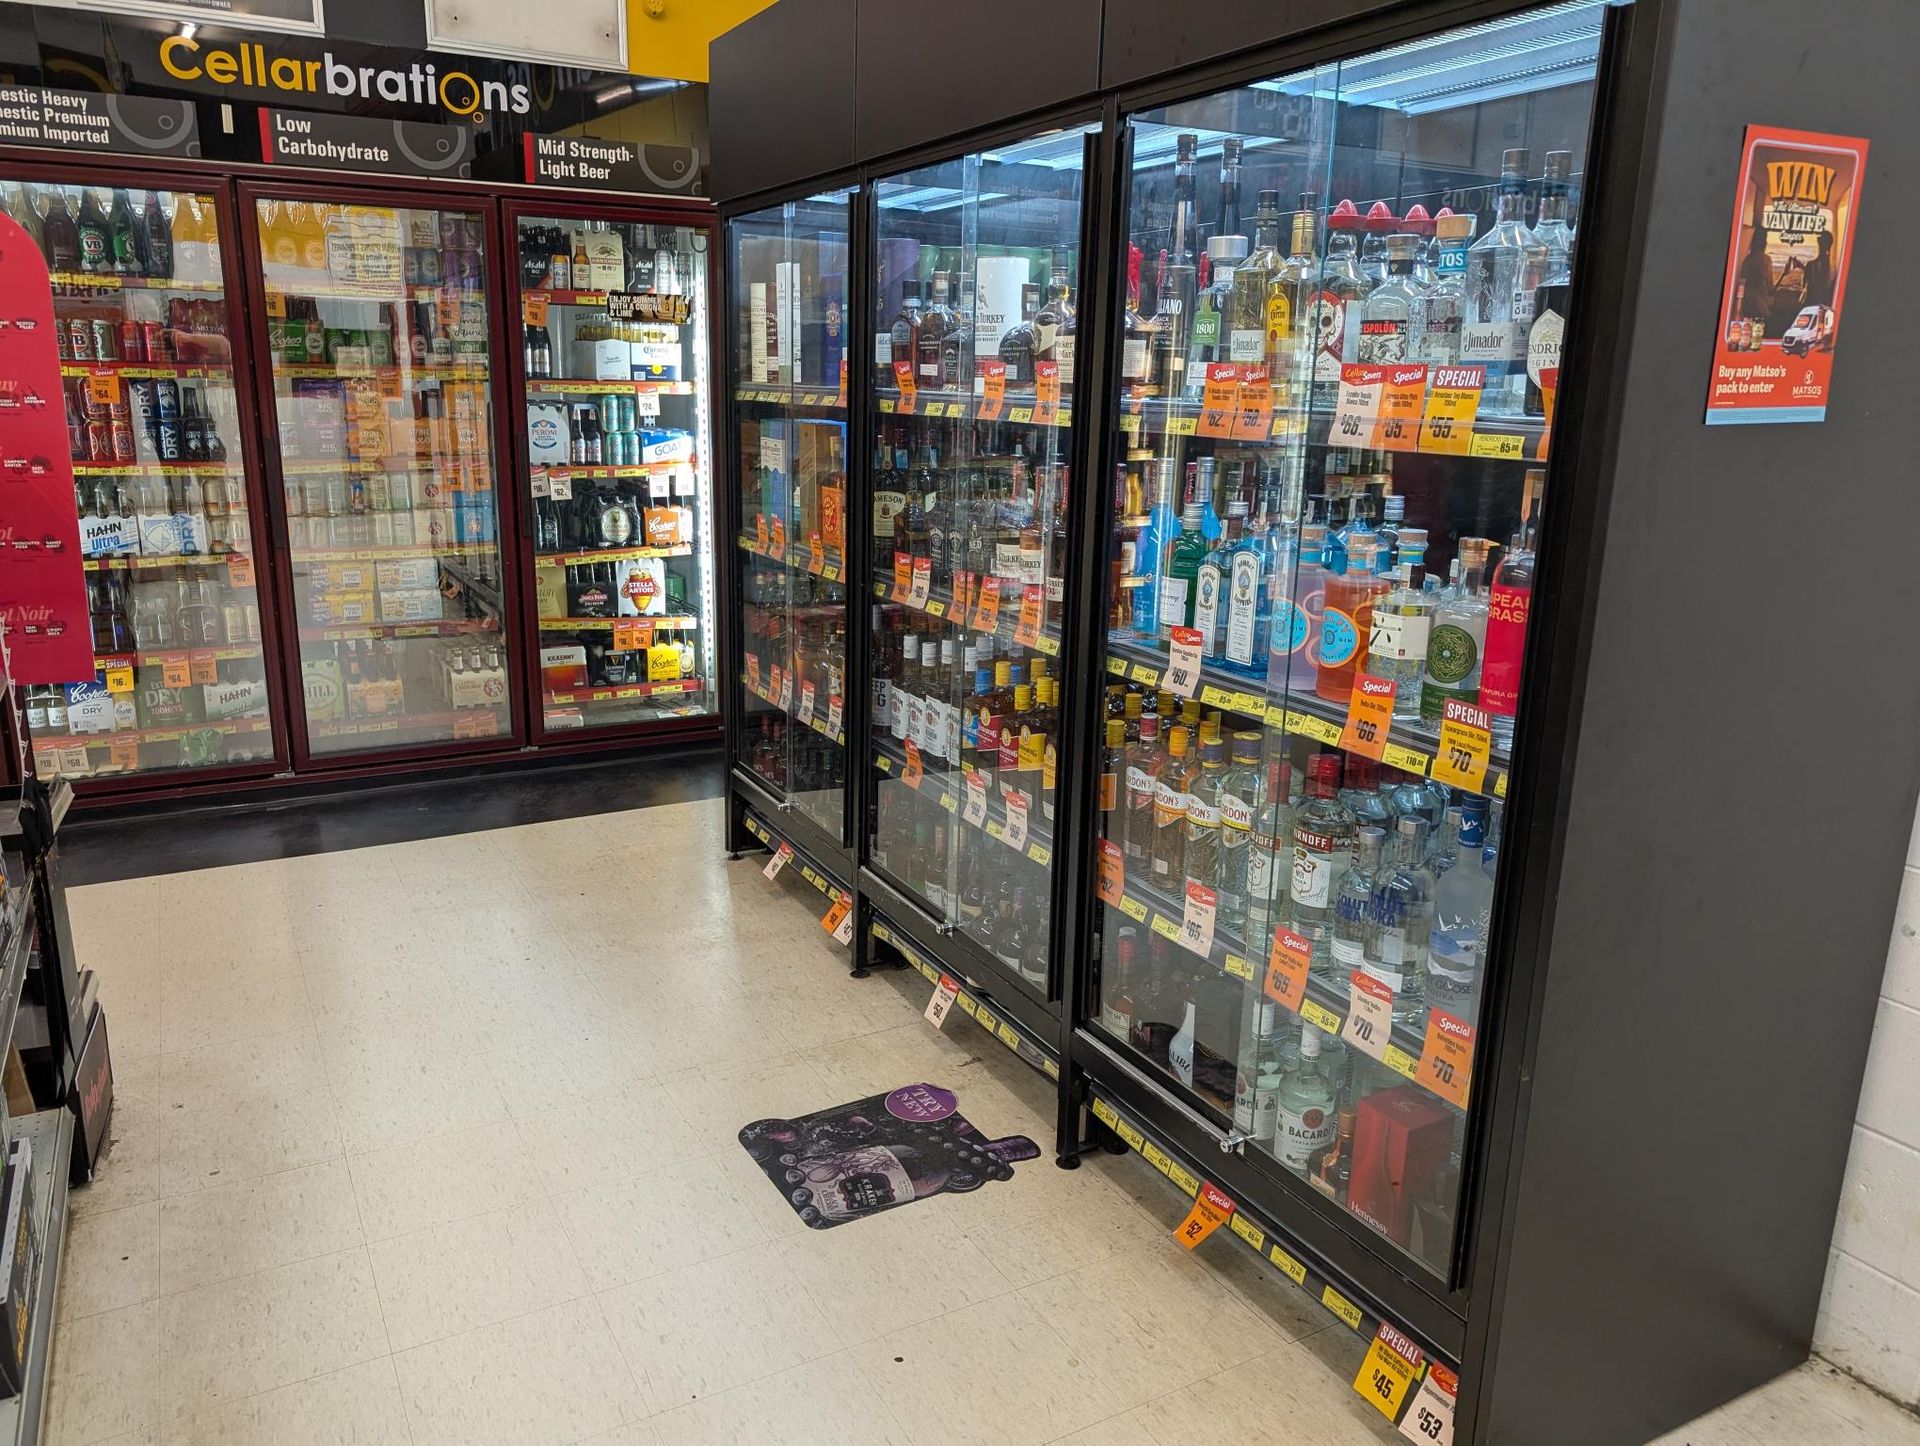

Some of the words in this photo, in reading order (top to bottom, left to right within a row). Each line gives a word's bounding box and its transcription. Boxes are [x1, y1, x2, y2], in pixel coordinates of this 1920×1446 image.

[160, 36, 529, 115] Cellarbrations
[42, 90, 88, 110] Heavy
[44, 109, 110, 127] Premium
[275, 115, 312, 134] Low
[43, 124, 110, 144] Imported
[278, 135, 390, 163] Carbohydrate
[537, 138, 568, 159] Mid
[538, 159, 576, 180] Light
[579, 162, 611, 180] Beer
[1766, 161, 1836, 204] WIN
[1763, 211, 1790, 230] VAN
[1792, 213, 1825, 231] LIFE
[86, 239, 102, 249] VB
[524, 259, 546, 270] Asahi
[635, 260, 653, 270] Asahi
[1440, 254, 1464, 267] TOS
[609, 295, 632, 304] ENJOY
[633, 296, 662, 304] SUMMER
[609, 303, 629, 311] WITH
[635, 303, 662, 311] CORONA
[979, 312, 1005, 325] TURKEY
[1195, 323, 1215, 334] 1800
[1467, 333, 1504, 353] Jimador
[1213, 366, 1236, 382] Special
[1245, 368, 1266, 383] Special
[1362, 371, 1382, 381] Savers
[1393, 367, 1424, 385] Special
[1436, 369, 1481, 387] SPECIAL
[1718, 365, 1735, 380] Buy
[1737, 368, 1752, 380] any
[1753, 365, 1787, 378] Matso's
[1715, 382, 1739, 397] pack
[1739, 383, 1748, 393] to
[1749, 383, 1775, 393] enter
[1792, 385, 1823, 396] MATSO'S
[139, 384, 152, 418] DRY
[1500, 442, 1520, 453] 85.00
[874, 494, 905, 504] AMESON
[86, 522, 122, 539] HAHN
[182, 514, 195, 554] DRY
[91, 535, 120, 550] Ultra
[17, 604, 54, 622] Noir
[105, 660, 130, 668] SPECIAL
[547, 654, 575, 662] KILKENNY
[1171, 667, 1188, 686] $60
[71, 685, 110, 703] Coopers
[219, 686, 252, 704] HAHN
[1362, 681, 1392, 694] Special
[145, 689, 183, 707] DRY
[82, 706, 103, 715] DRY
[1447, 702, 1489, 729] SPECIAL
[1448, 746, 1473, 773] $70
[1104, 845, 1122, 857] Special
[1282, 935, 1309, 952] Special
[1371, 983, 1390, 999] Savers
[1353, 1013, 1373, 1041] $70
[1439, 1017, 1471, 1038] Special
[1432, 1055, 1455, 1085] $70
[896, 1093, 931, 1118] NEW
[913, 1087, 948, 1114] TRY
[1207, 1190, 1231, 1209] Special
[1351, 1200, 1389, 1235] Hennessy
[1186, 1219, 1203, 1241] $52
[1380, 1325, 1419, 1364] SPECIAL
[1372, 1368, 1395, 1400] $45
[1417, 1406, 1443, 1439] $53
